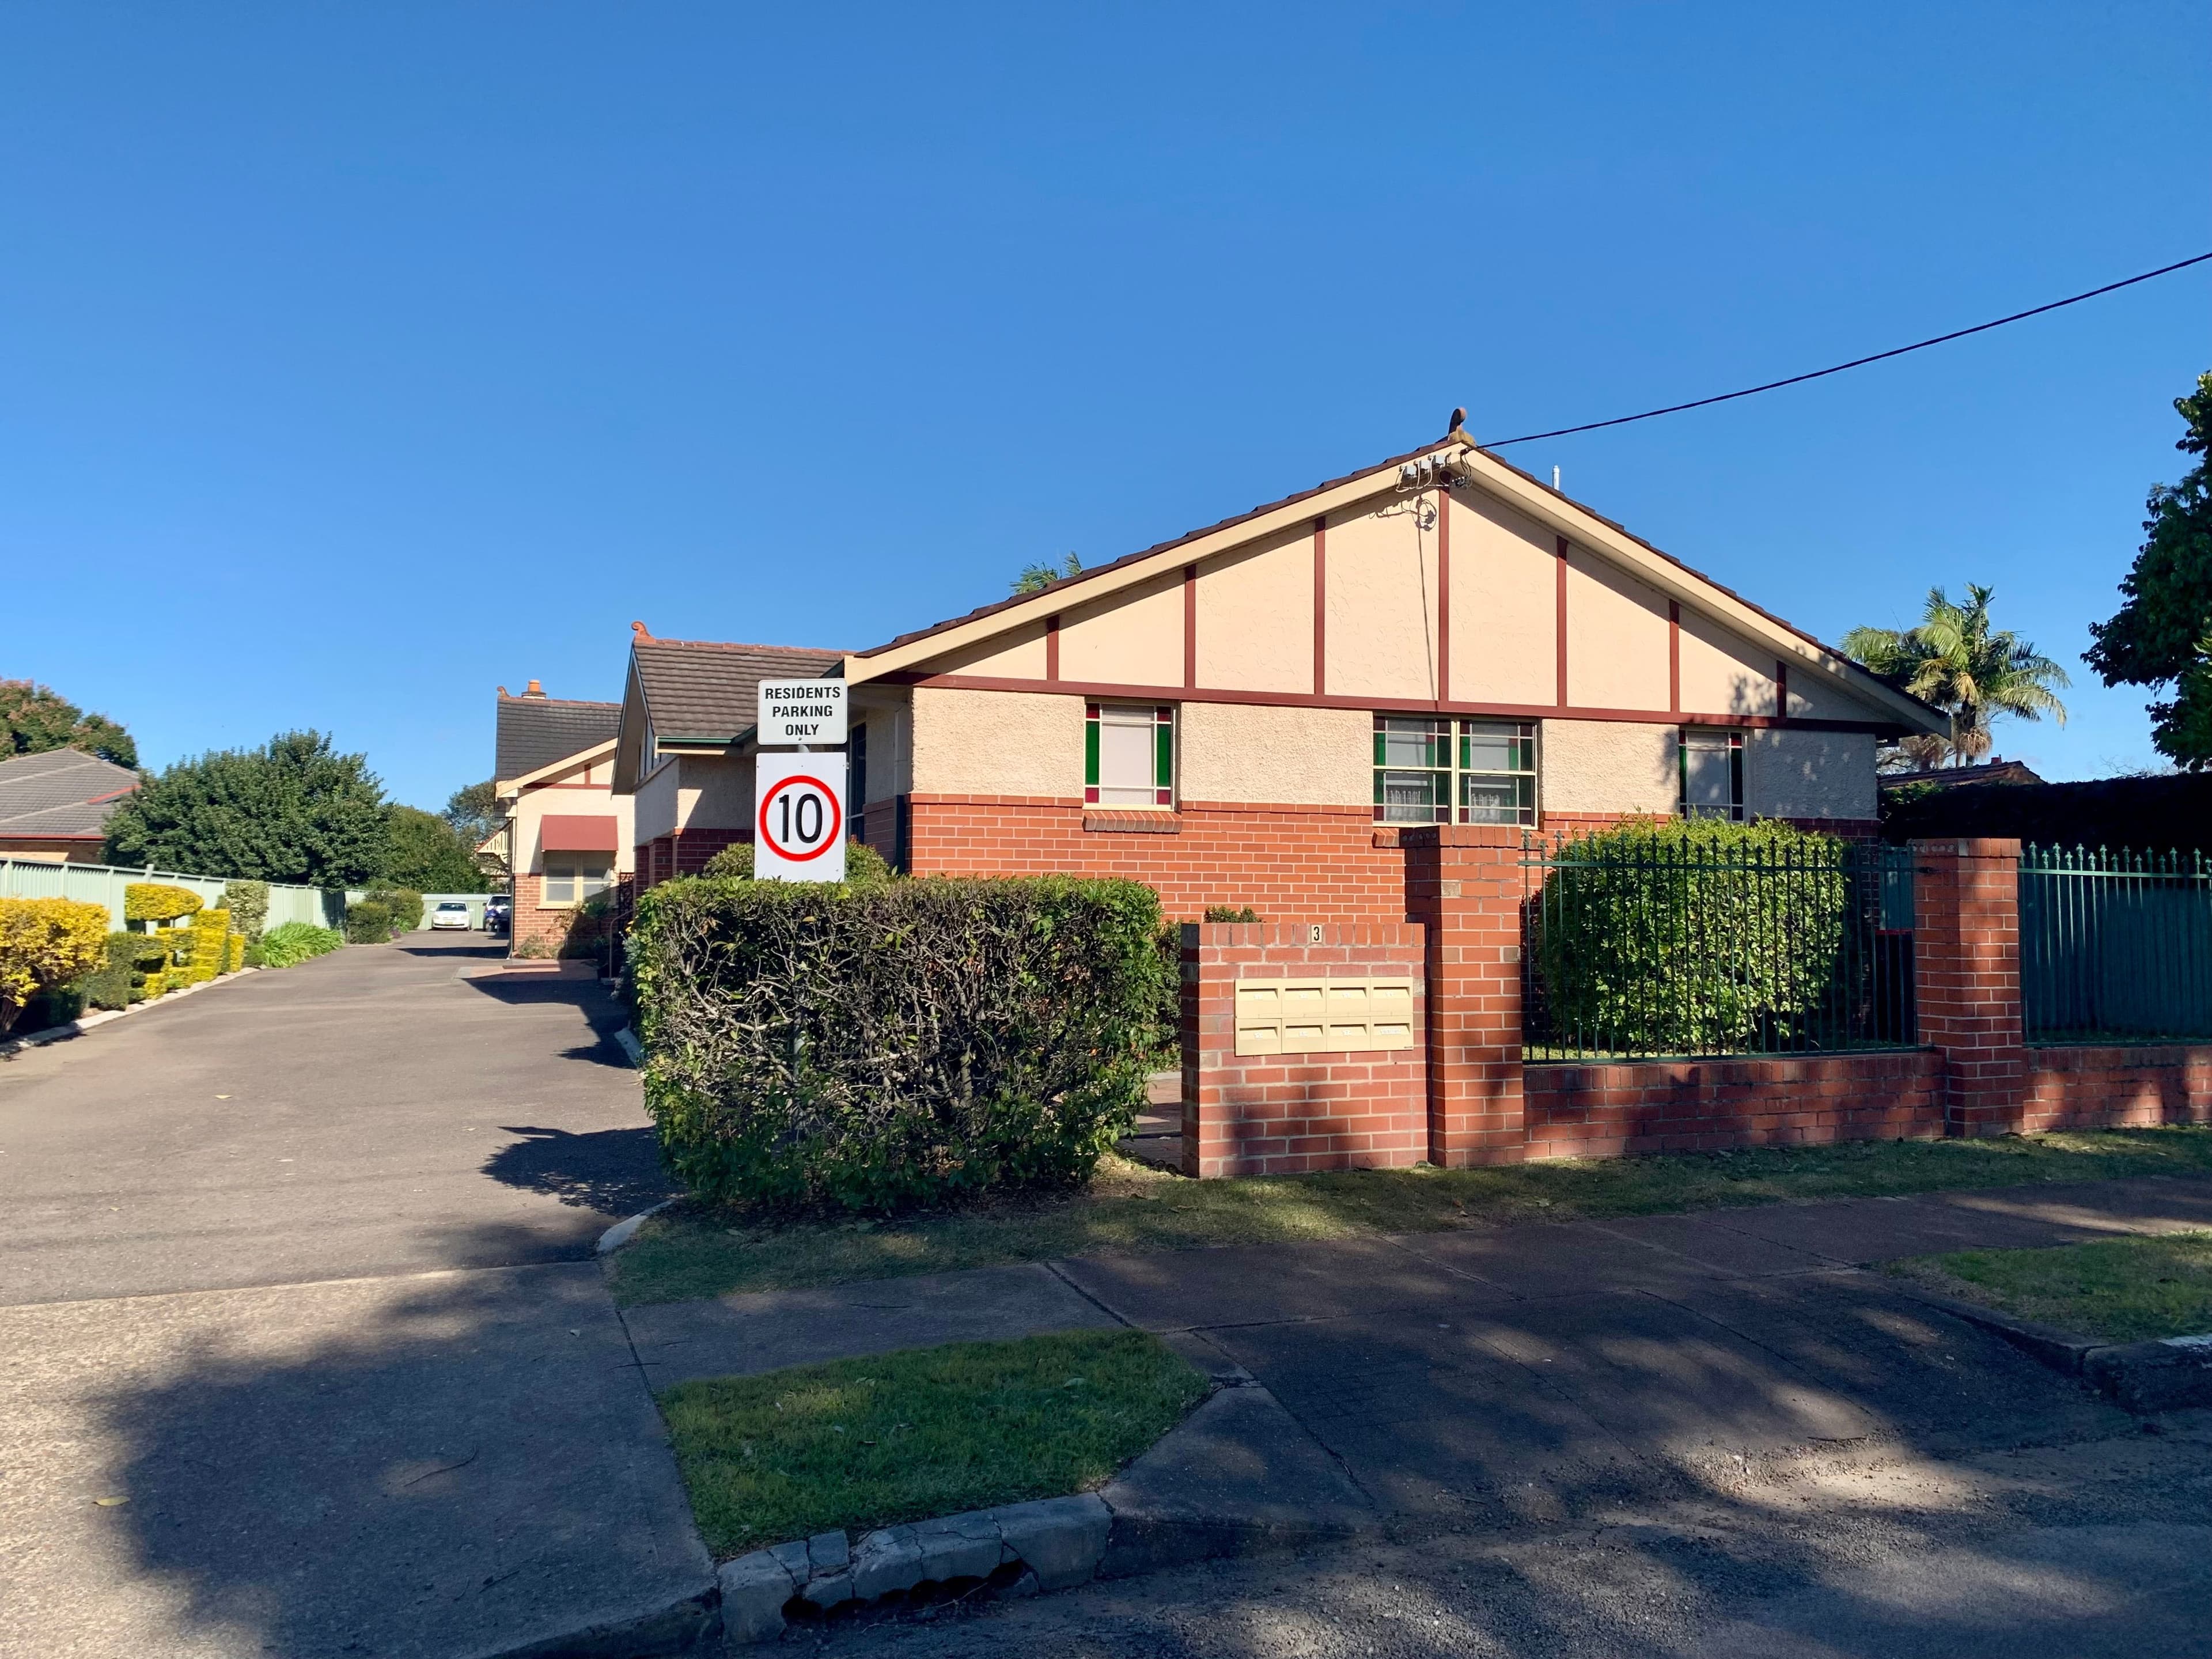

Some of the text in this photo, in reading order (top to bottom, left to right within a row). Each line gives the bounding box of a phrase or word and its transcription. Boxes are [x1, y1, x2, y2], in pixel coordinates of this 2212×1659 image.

[765, 687, 840, 699] RESIDENTS
[772, 705, 833, 717] PARKING
[785, 724, 819, 736] ONLY
[779, 793, 823, 843] 10
[1314, 926, 1320, 941] 3
